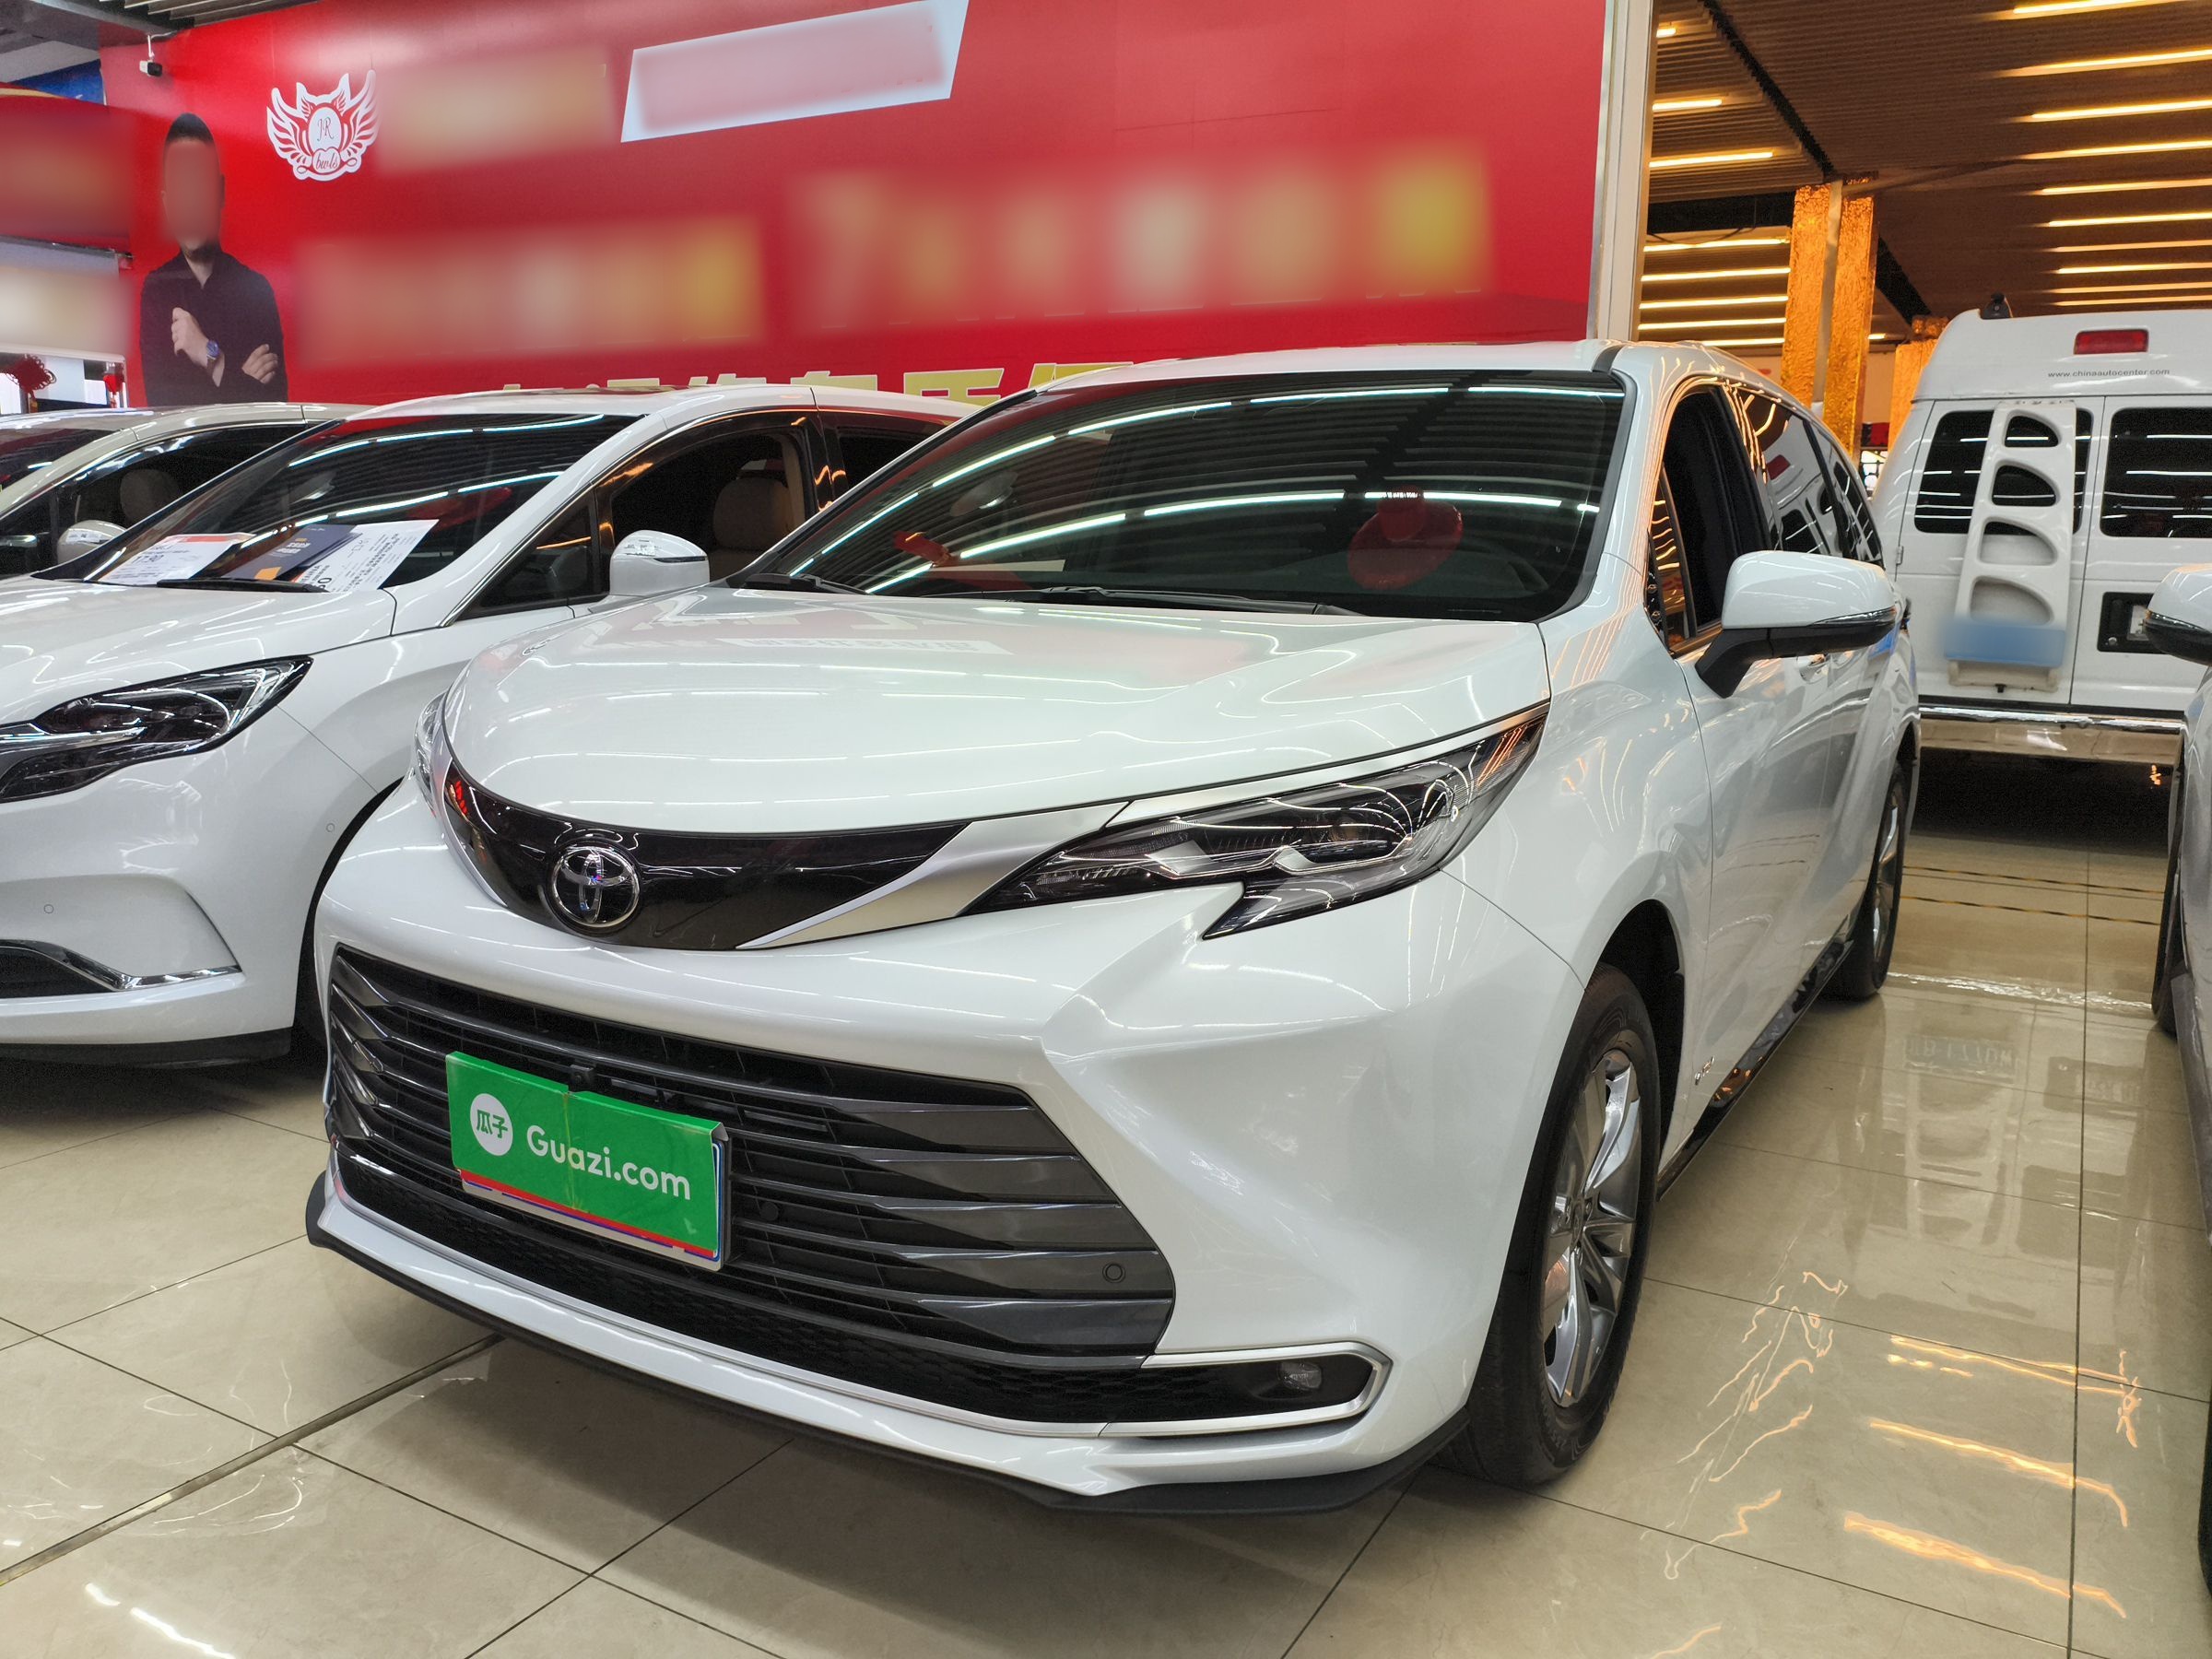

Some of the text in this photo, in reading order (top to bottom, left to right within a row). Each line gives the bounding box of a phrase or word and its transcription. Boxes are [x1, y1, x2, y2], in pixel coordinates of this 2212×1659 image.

[2048, 369, 2170, 378] www.chinaautocenter.com
[476, 1109, 509, 1139] 瓜子
[525, 1124, 691, 1200] Guazi.com
